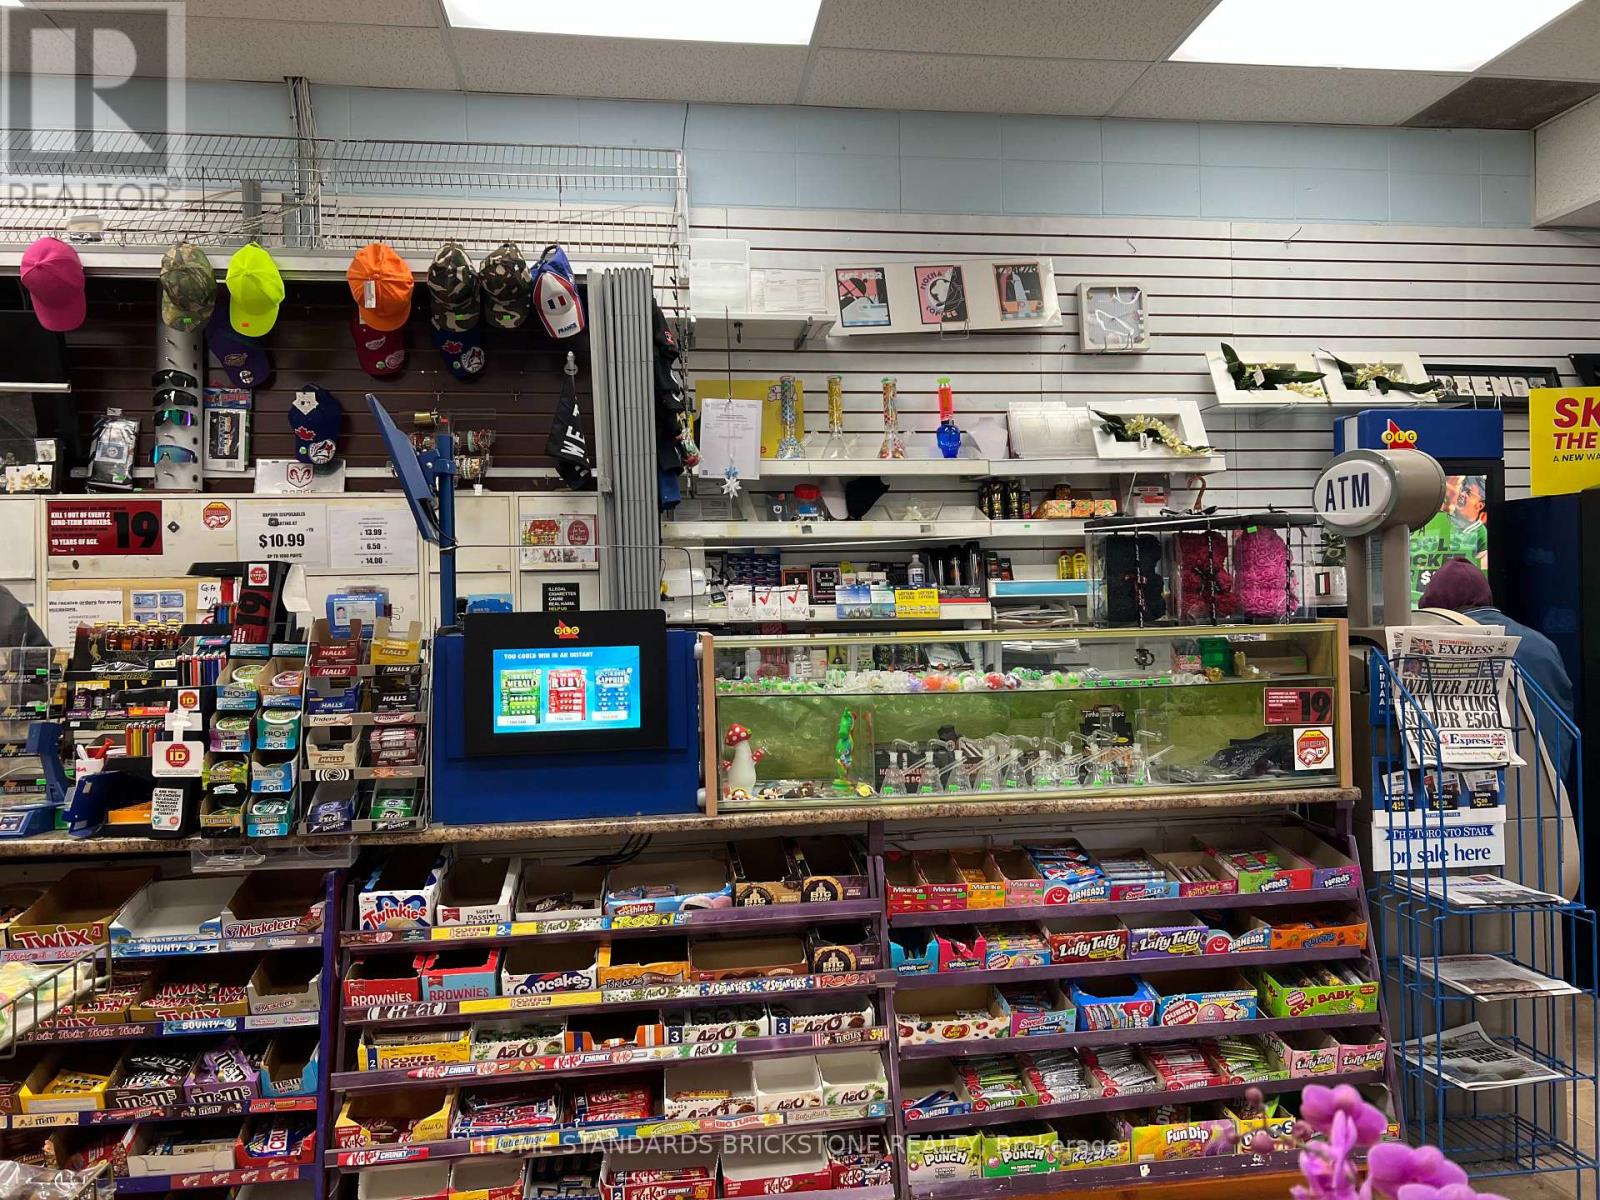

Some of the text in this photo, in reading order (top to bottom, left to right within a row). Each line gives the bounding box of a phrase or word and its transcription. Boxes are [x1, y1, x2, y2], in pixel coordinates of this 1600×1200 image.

[557, 322, 578, 335] FRANCE
[1383, 430, 1418, 443] OLG
[1553, 432, 1598, 450] THE
[1562, 454, 1585, 462] NEW
[1325, 472, 1371, 513] ATM
[113, 511, 159, 549] 19
[258, 533, 305, 549] $10.99
[554, 626, 580, 636] OLG
[382, 648, 407, 656] HALLS
[1438, 643, 1495, 655] EXPRESS
[1298, 690, 1331, 722] 19
[1435, 695, 1499, 711] VICTIMS
[1449, 733, 1491, 746] Express
[1463, 826, 1489, 837] STAR
[1454, 843, 1491, 861] here
[363, 902, 427, 930] Twinkies
[239, 918, 301, 938] Musketeers
[144, 943, 183, 953] BOUNTY
[1060, 933, 1121, 956] Laffy Taffy
[1139, 928, 1201, 952] Laffy Taffy
[515, 974, 592, 996] Cupcakes
[1317, 989, 1354, 1004] BABY
[1164, 1002, 1196, 1022] DUBBLE
[778, 1022, 788, 1034] 3
[803, 1015, 843, 1033] Aero
[671, 1031, 680, 1043] 3
[696, 1025, 737, 1042] Aero
[370, 1059, 377, 1068] 2
[841, 1089, 869, 1105] Aero
[1166, 1126, 1210, 1145] Fun Dip
[924, 1151, 968, 1166] PUNCH
[1001, 1148, 1046, 1164] PUNCH
